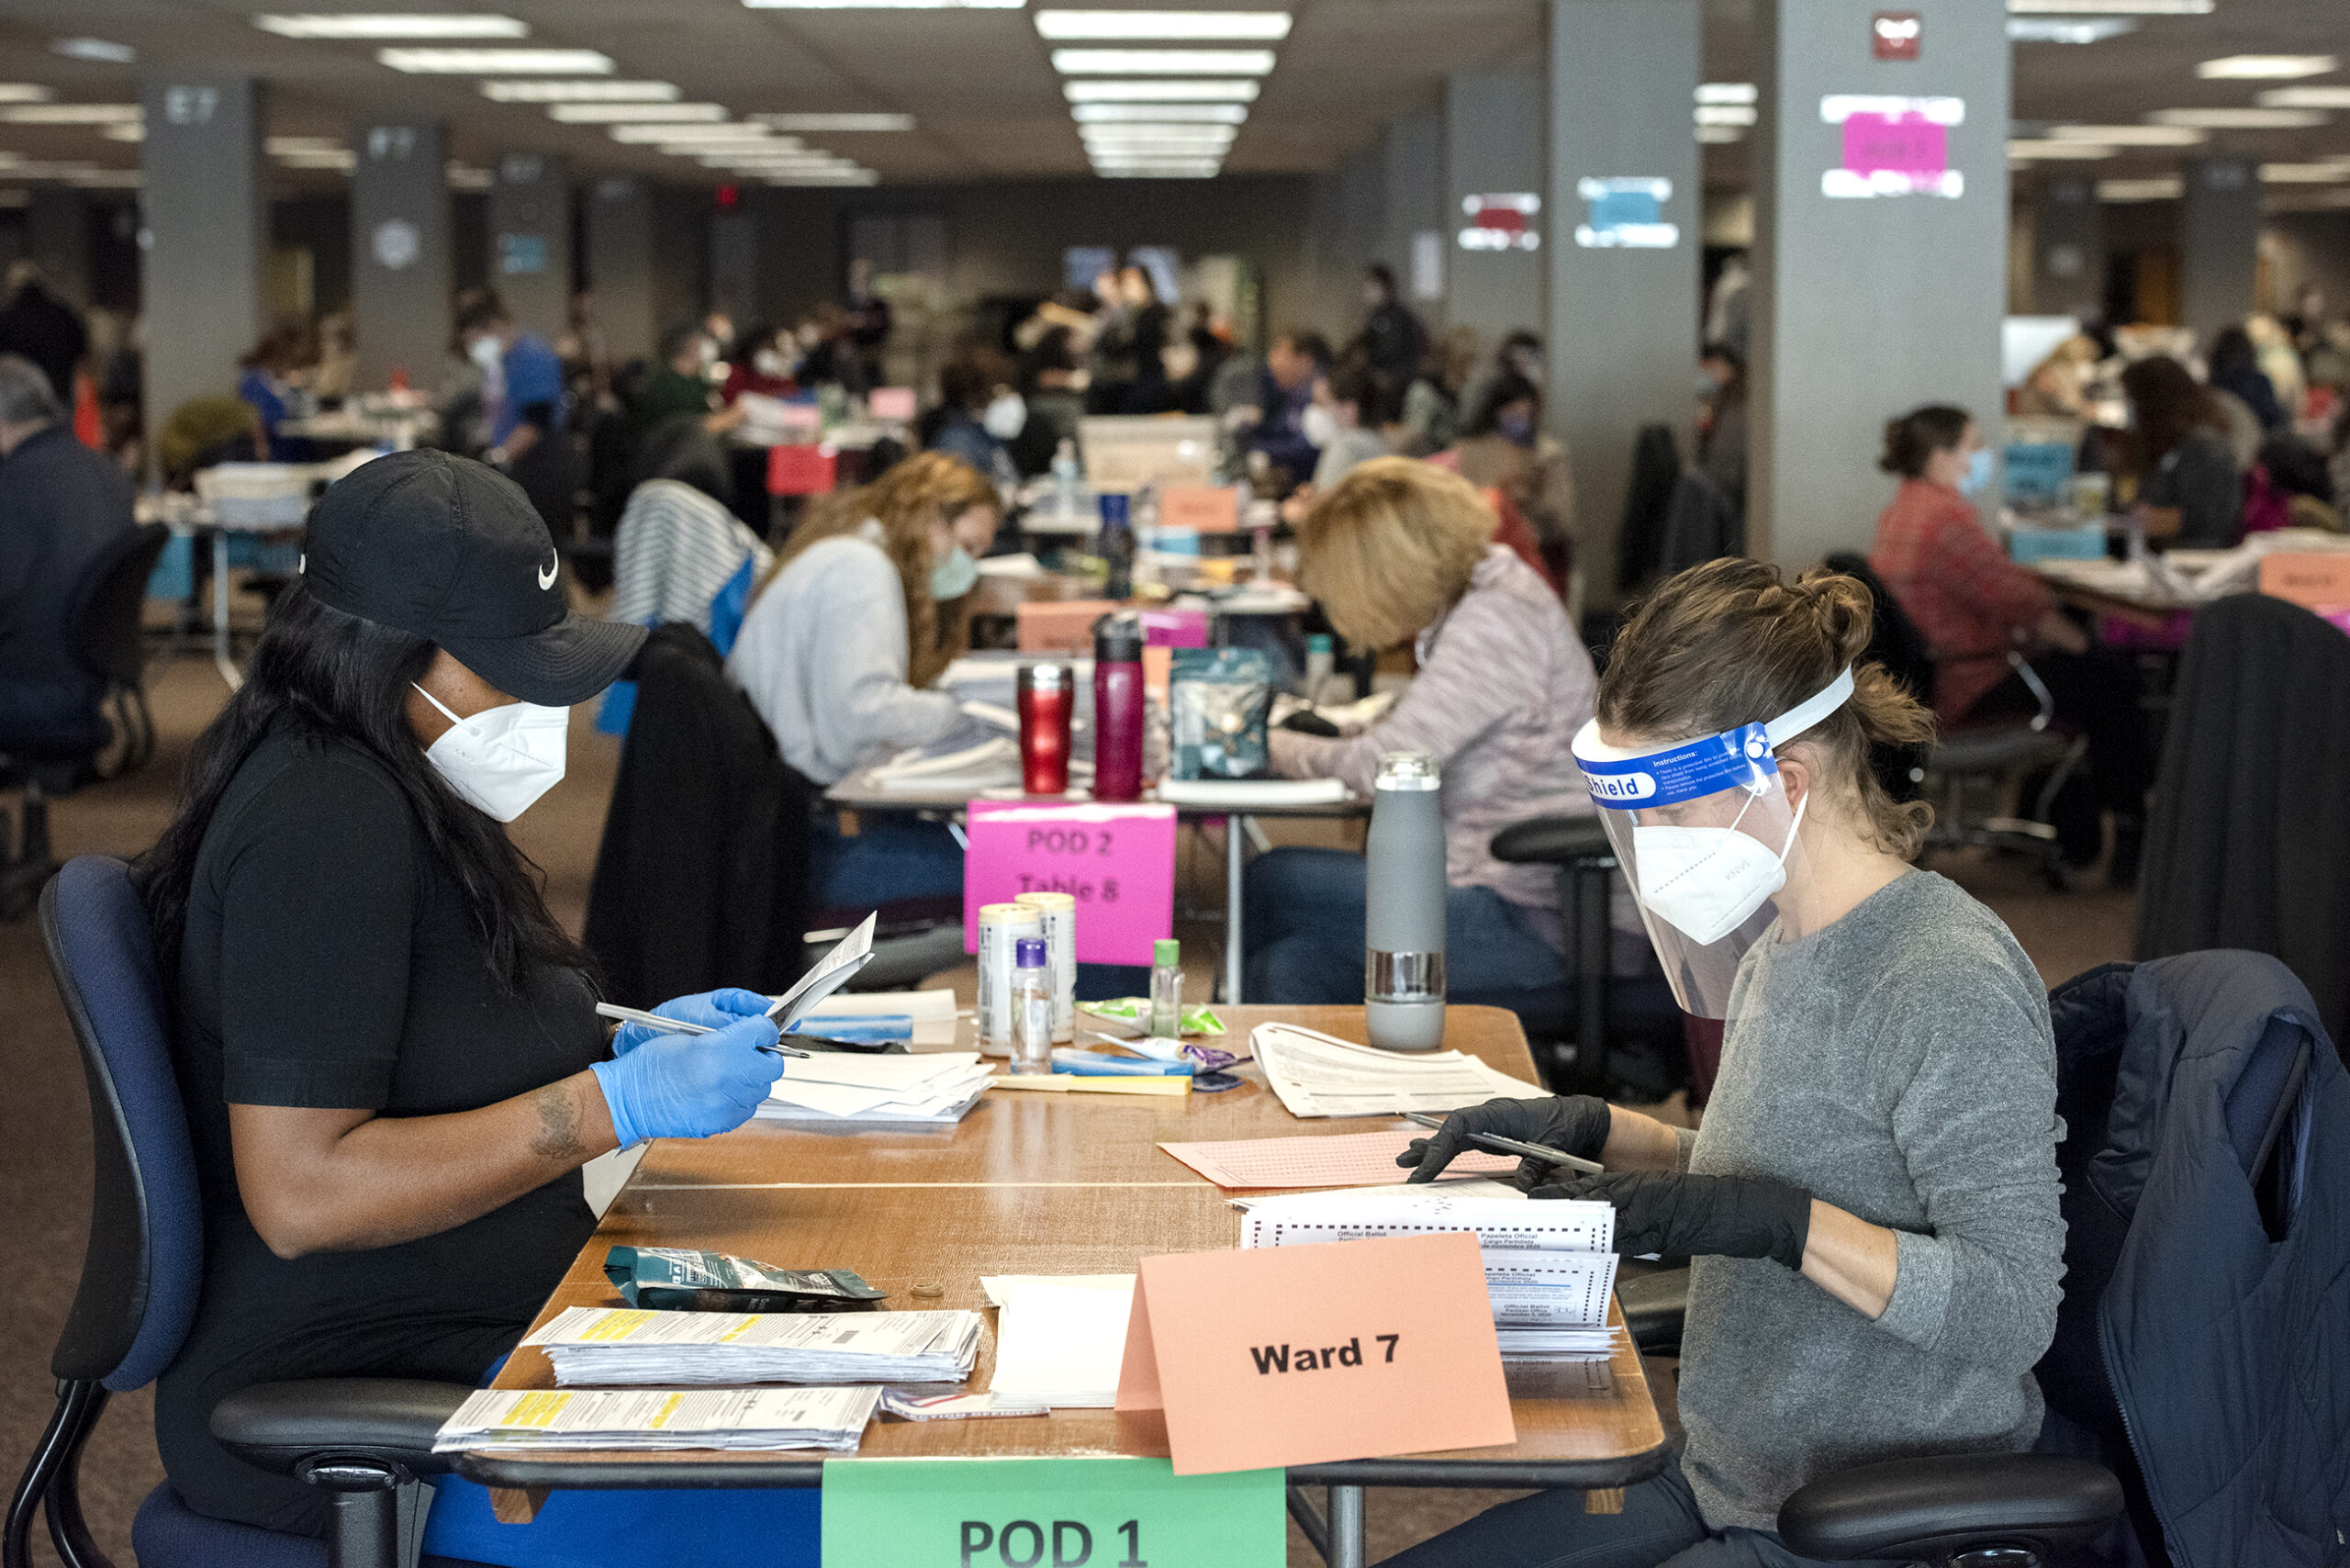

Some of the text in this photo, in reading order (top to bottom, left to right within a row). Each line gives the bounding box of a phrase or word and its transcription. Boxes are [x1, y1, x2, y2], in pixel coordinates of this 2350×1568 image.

[1653, 750, 1698, 767] Instructions:
[1683, 760, 1704, 769] protective
[1584, 778, 1639, 796] Shield
[1027, 827, 1113, 857] POD 2
[1018, 874, 1119, 902] Table 8
[1250, 1334, 1400, 1375] Ward 7
[961, 1519, 1147, 1568] POD 1
